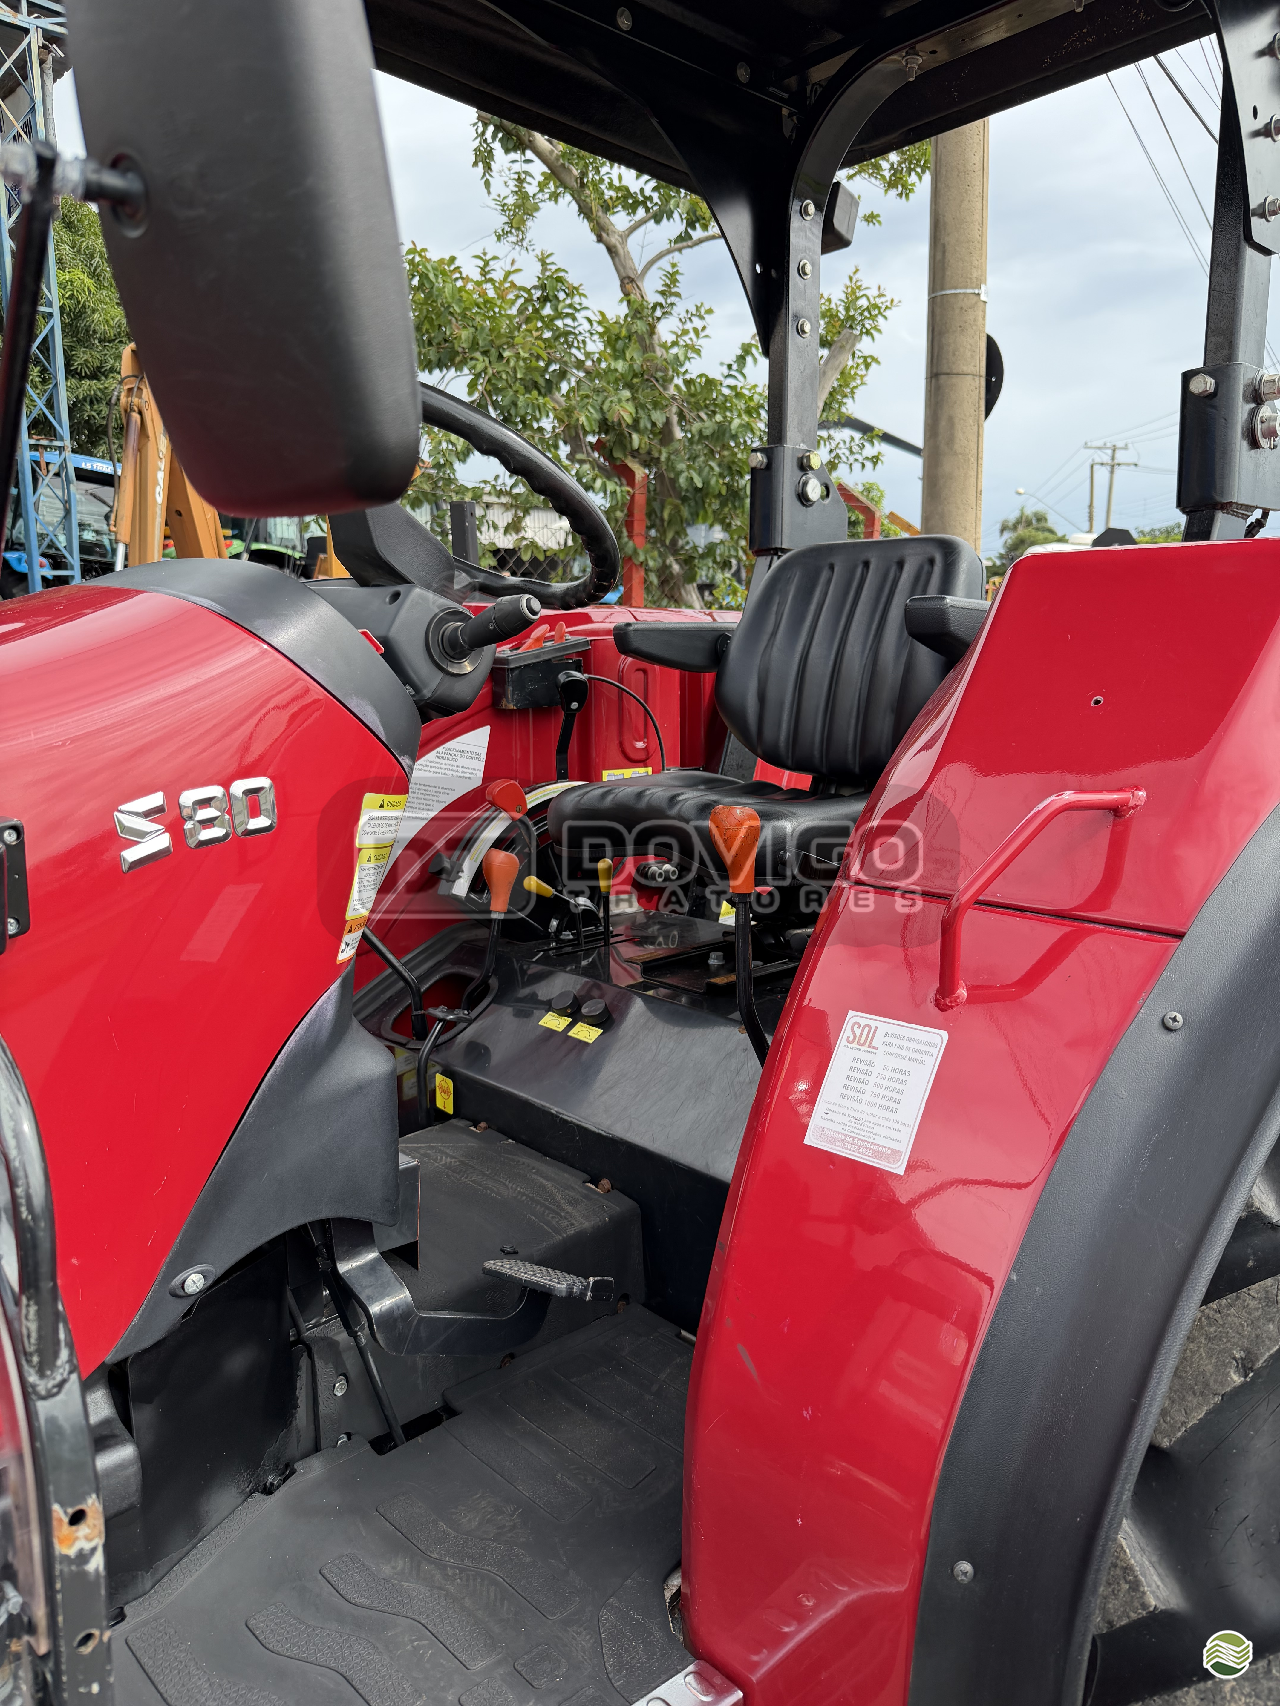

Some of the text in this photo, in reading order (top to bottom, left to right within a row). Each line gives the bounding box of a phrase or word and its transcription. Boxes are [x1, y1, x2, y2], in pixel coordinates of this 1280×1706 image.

[846, 1022, 879, 1050] SOL
[849, 1066, 873, 1077] REVISÃO
[886, 1075, 908, 1086] HORAS
[852, 1057, 876, 1068] REVISÃO
[889, 1066, 911, 1077] HORAS
[843, 1084, 866, 1095] REVISÃO
[880, 1093, 902, 1105] HORAS
[846, 1075, 870, 1086] REVISÃO
[883, 1084, 905, 1095] HORAS
[840, 1093, 863, 1104] REVISÃO
[877, 1102, 899, 1114] HORAS
